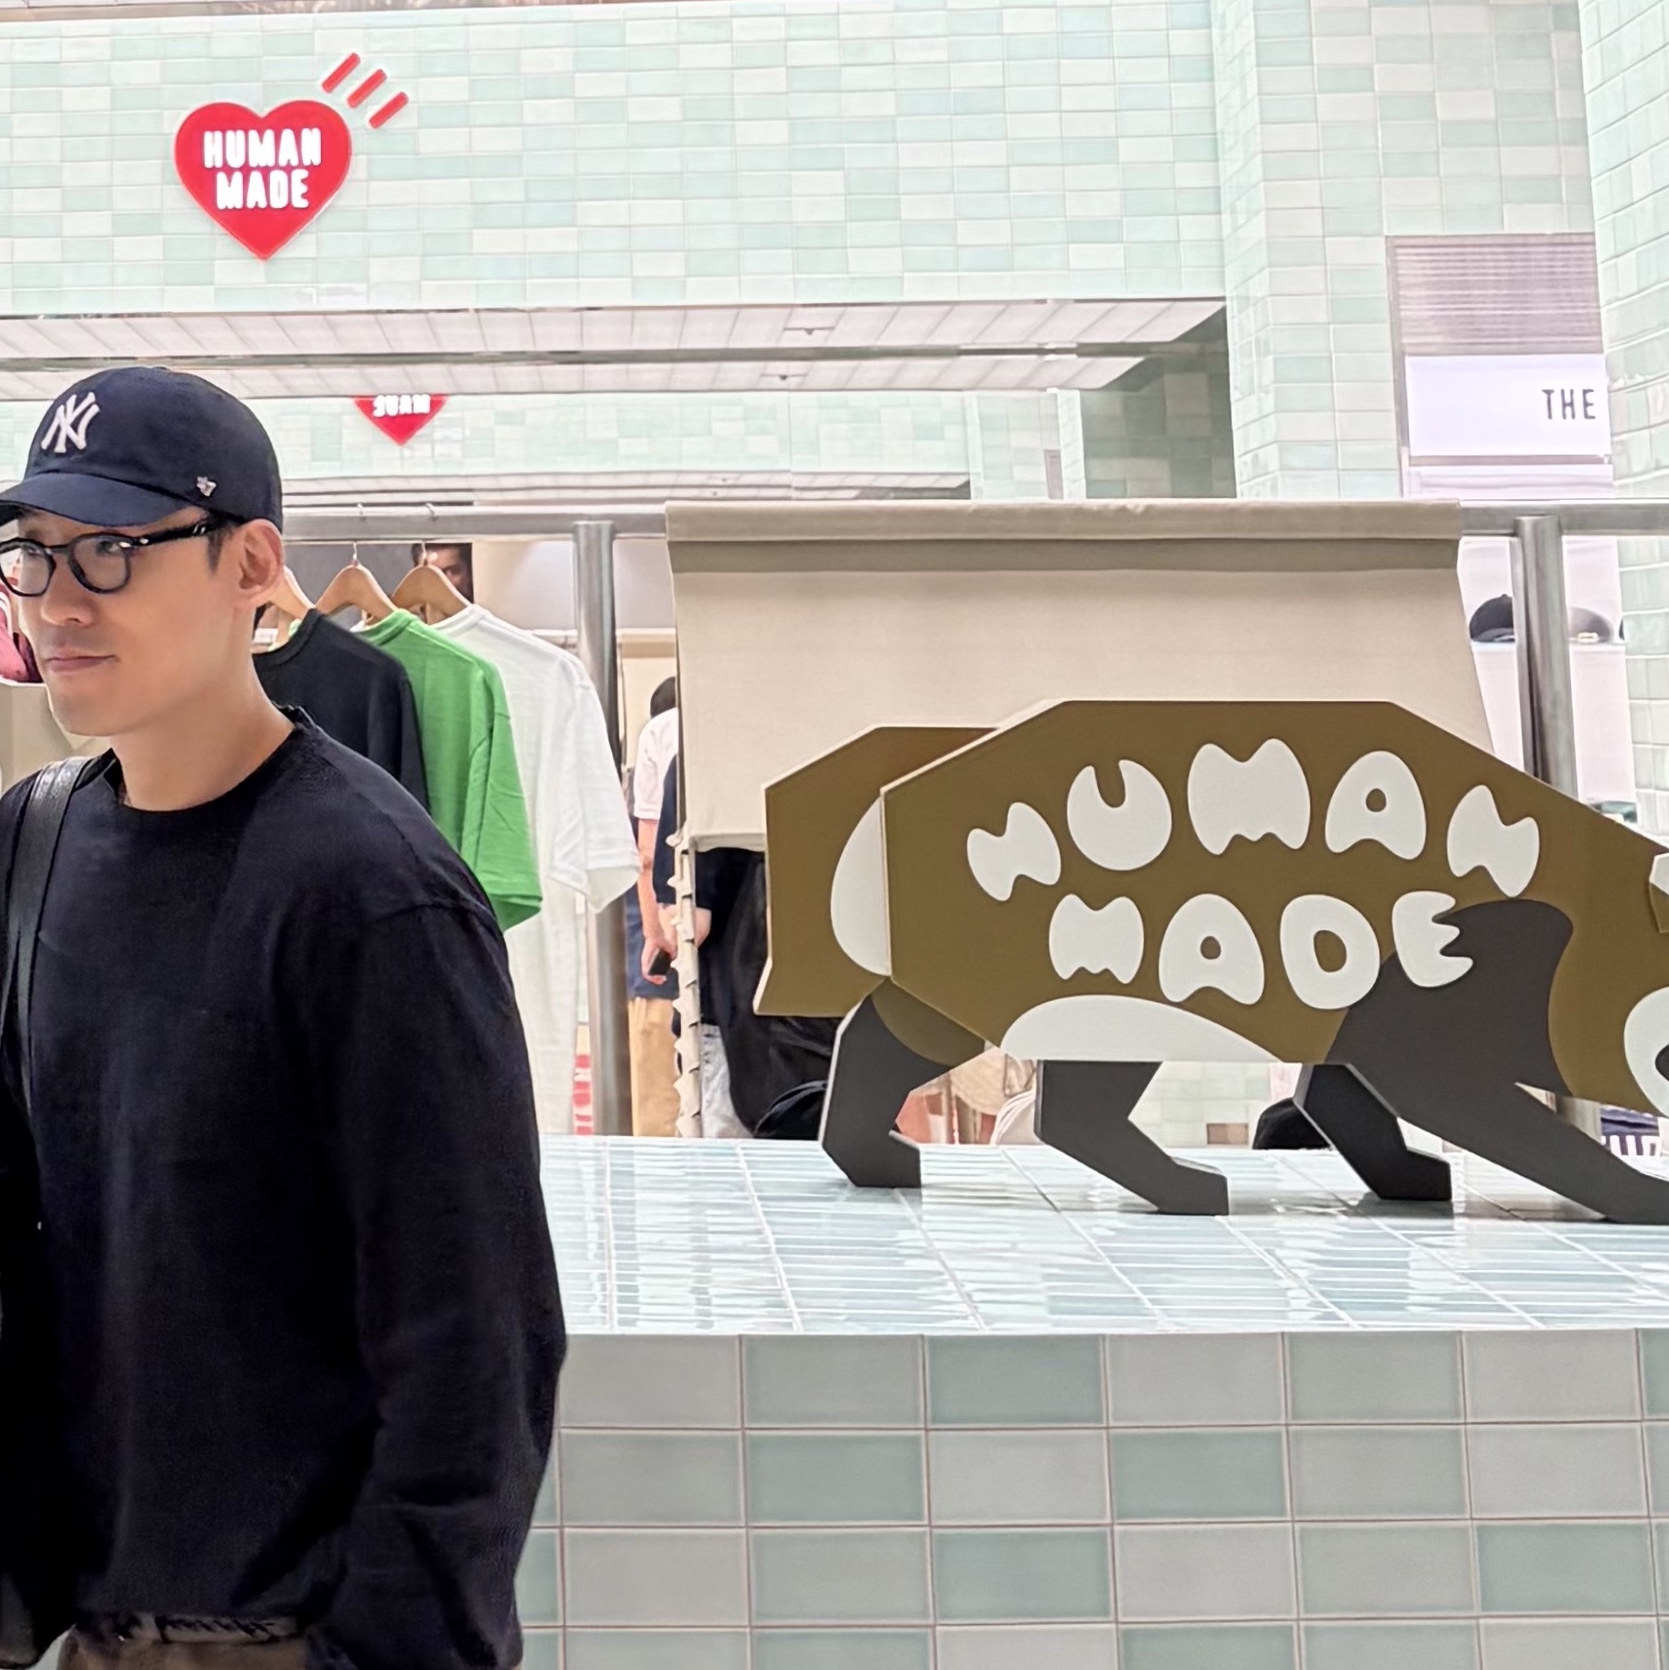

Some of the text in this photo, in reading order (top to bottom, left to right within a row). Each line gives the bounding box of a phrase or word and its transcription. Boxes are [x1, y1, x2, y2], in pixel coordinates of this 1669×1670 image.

[203, 127, 322, 169] HUMAN
[216, 168, 310, 210] MADE
[41, 391, 101, 453] NY
[1541, 388, 1596, 420] THE
[967, 737, 1541, 900] HUMAN
[1049, 890, 1474, 1010] MADE
